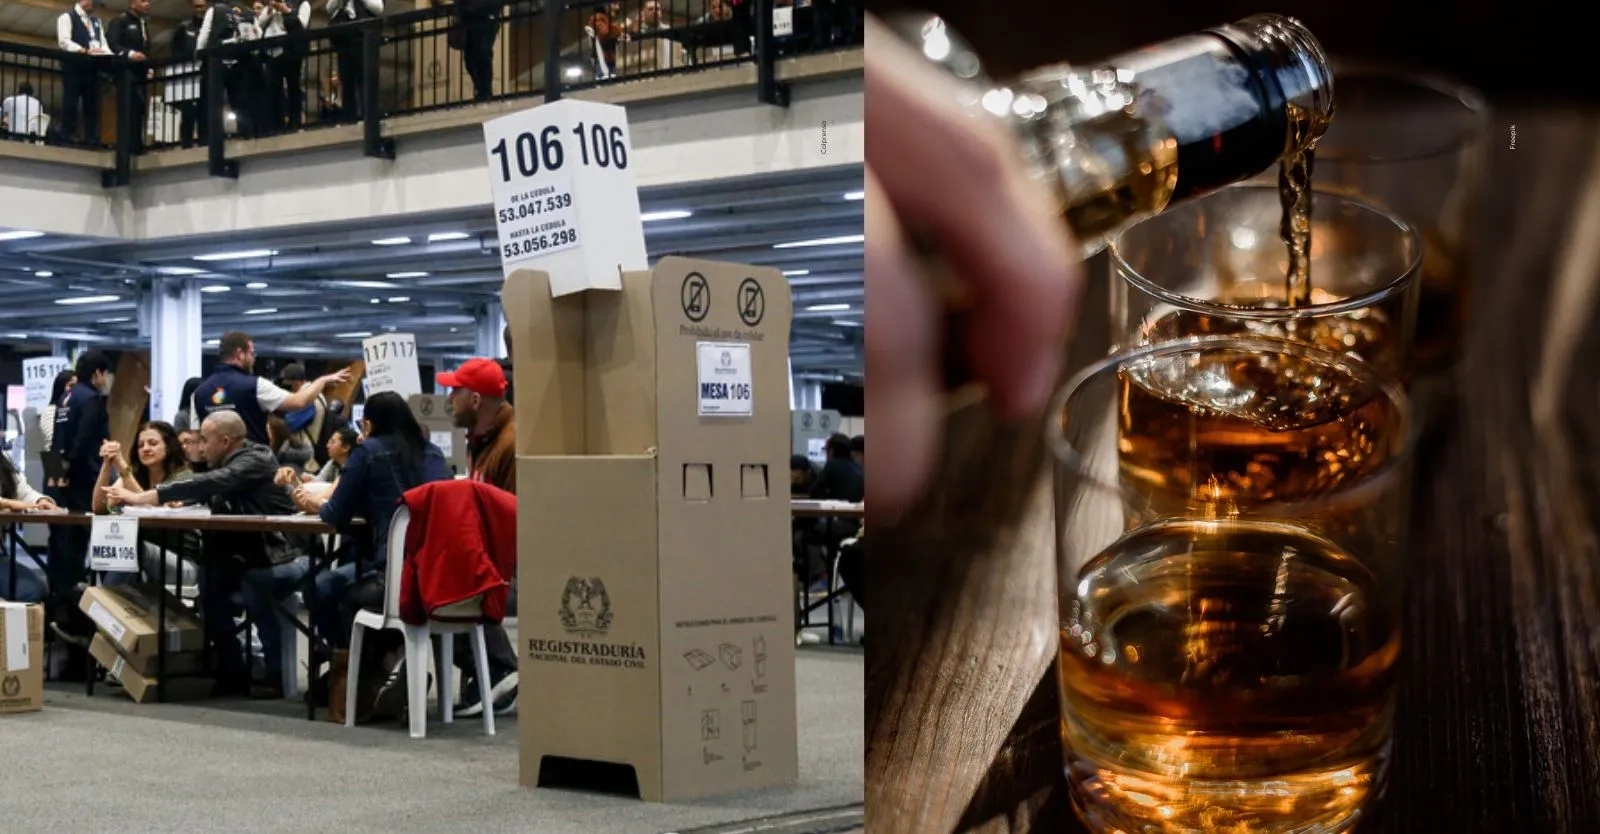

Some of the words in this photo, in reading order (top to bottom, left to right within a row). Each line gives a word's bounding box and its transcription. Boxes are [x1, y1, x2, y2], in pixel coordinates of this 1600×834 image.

[491, 125, 564, 182] 106
[572, 121, 627, 170] 106
[499, 192, 572, 223] 53.047.539
[503, 228, 577, 258] 53.056.298
[365, 341, 388, 363] 117
[392, 341, 415, 358] 117
[27, 364, 47, 378] 116
[701, 382, 728, 400] MESA
[730, 383, 750, 400] 106
[92, 545, 117, 559] MESA
[528, 638, 646, 660] REGISTRADURÍA
